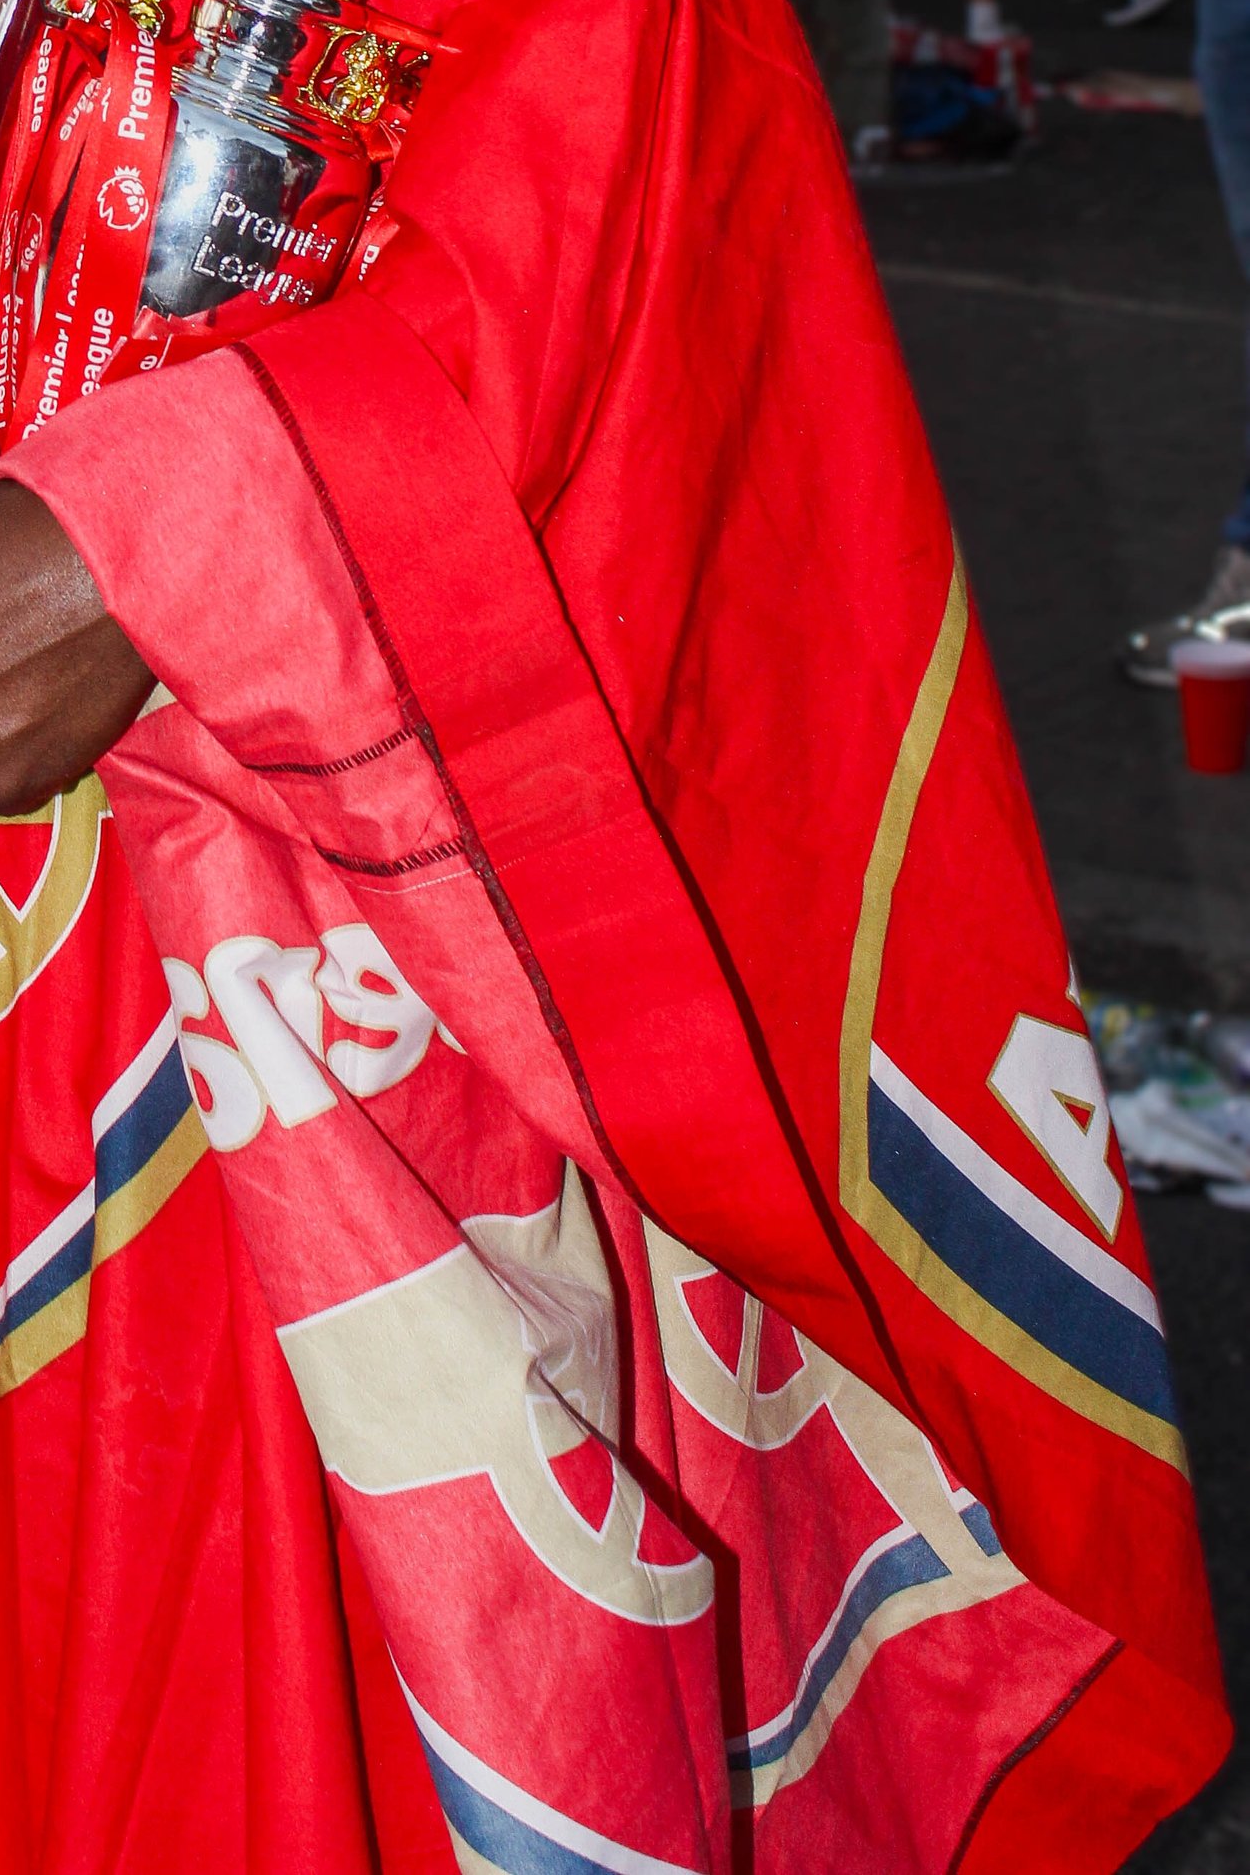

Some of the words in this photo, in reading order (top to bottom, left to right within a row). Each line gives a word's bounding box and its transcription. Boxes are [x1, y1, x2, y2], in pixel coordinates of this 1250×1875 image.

[117, 28, 157, 141] Premie
[210, 189, 338, 264] Premier
[191, 234, 316, 306] League
